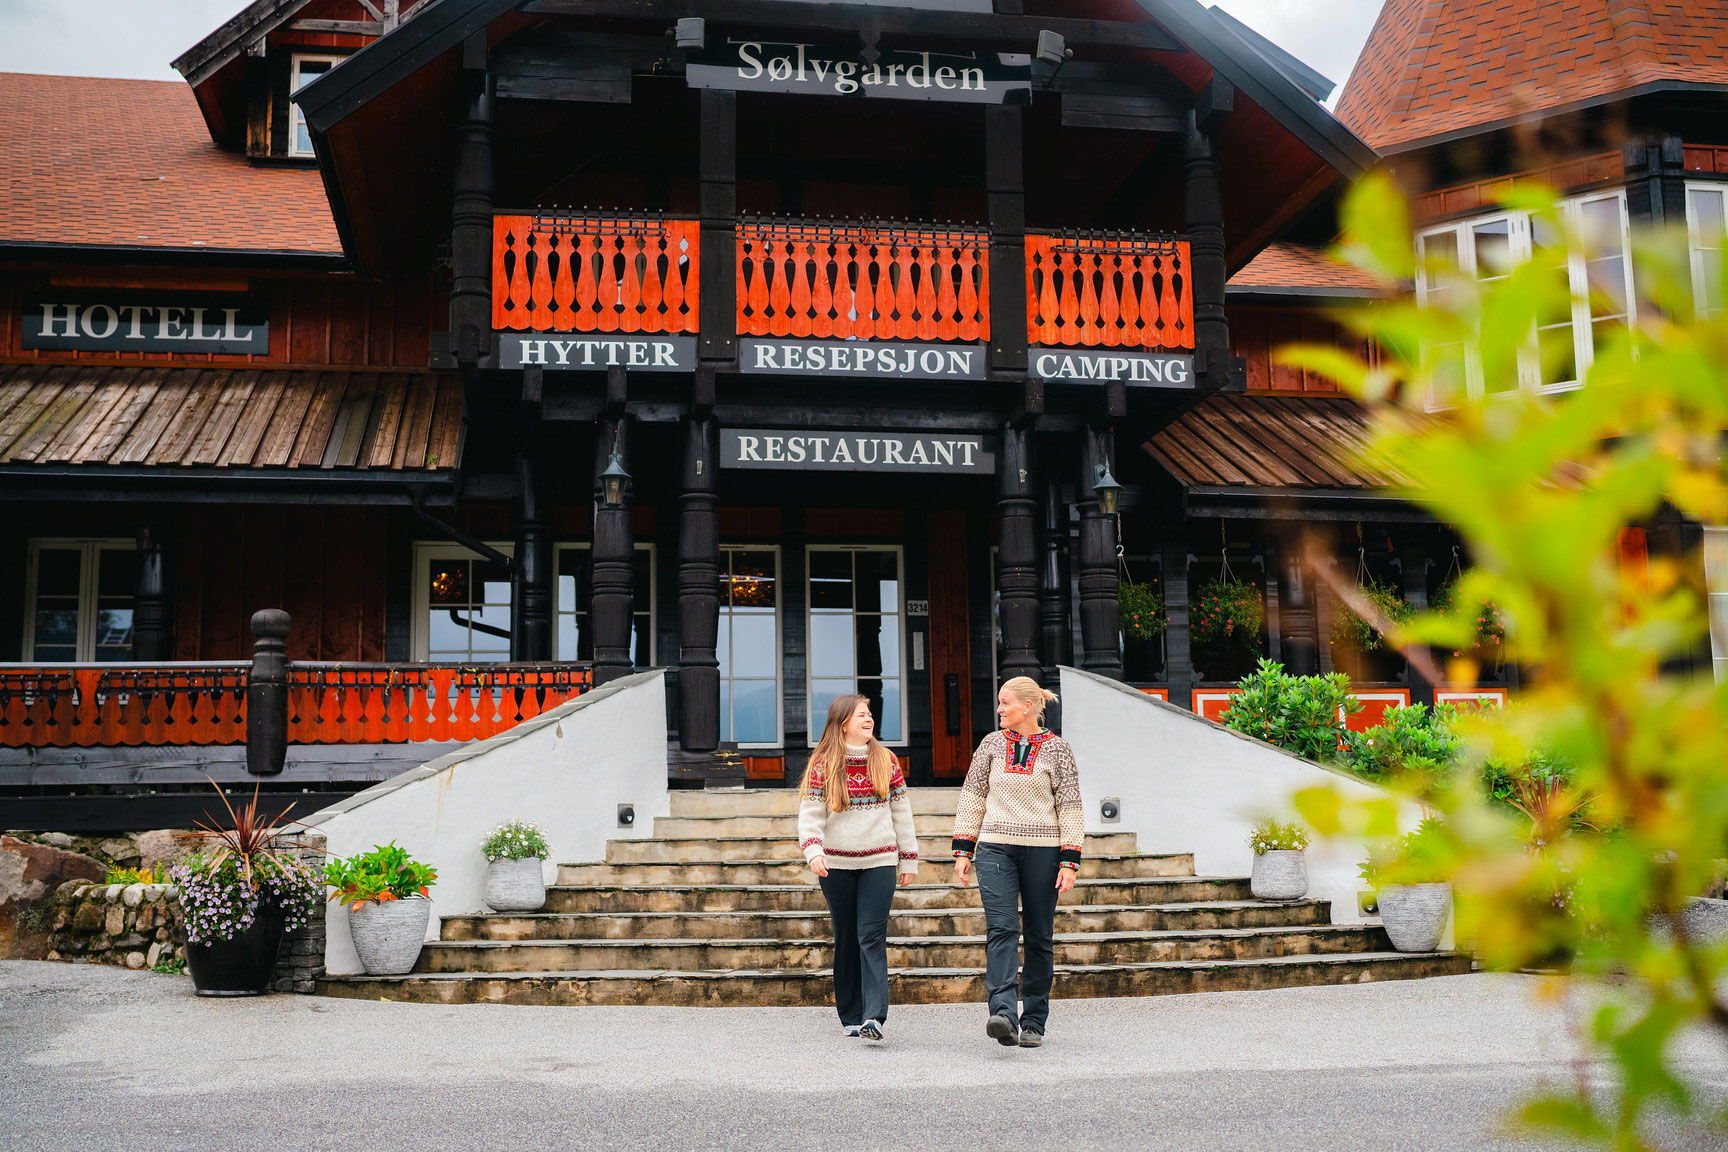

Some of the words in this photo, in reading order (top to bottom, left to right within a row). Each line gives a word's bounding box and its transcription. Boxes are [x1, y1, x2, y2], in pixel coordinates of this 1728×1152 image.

[37, 302, 253, 342] HOTELL
[517, 339, 679, 367] HYTTER
[753, 344, 974, 375] RESEPSJON
[1035, 354, 1189, 384] CAMPING
[736, 435, 979, 466] RESTAURANT
[908, 603, 929, 613] 3214
